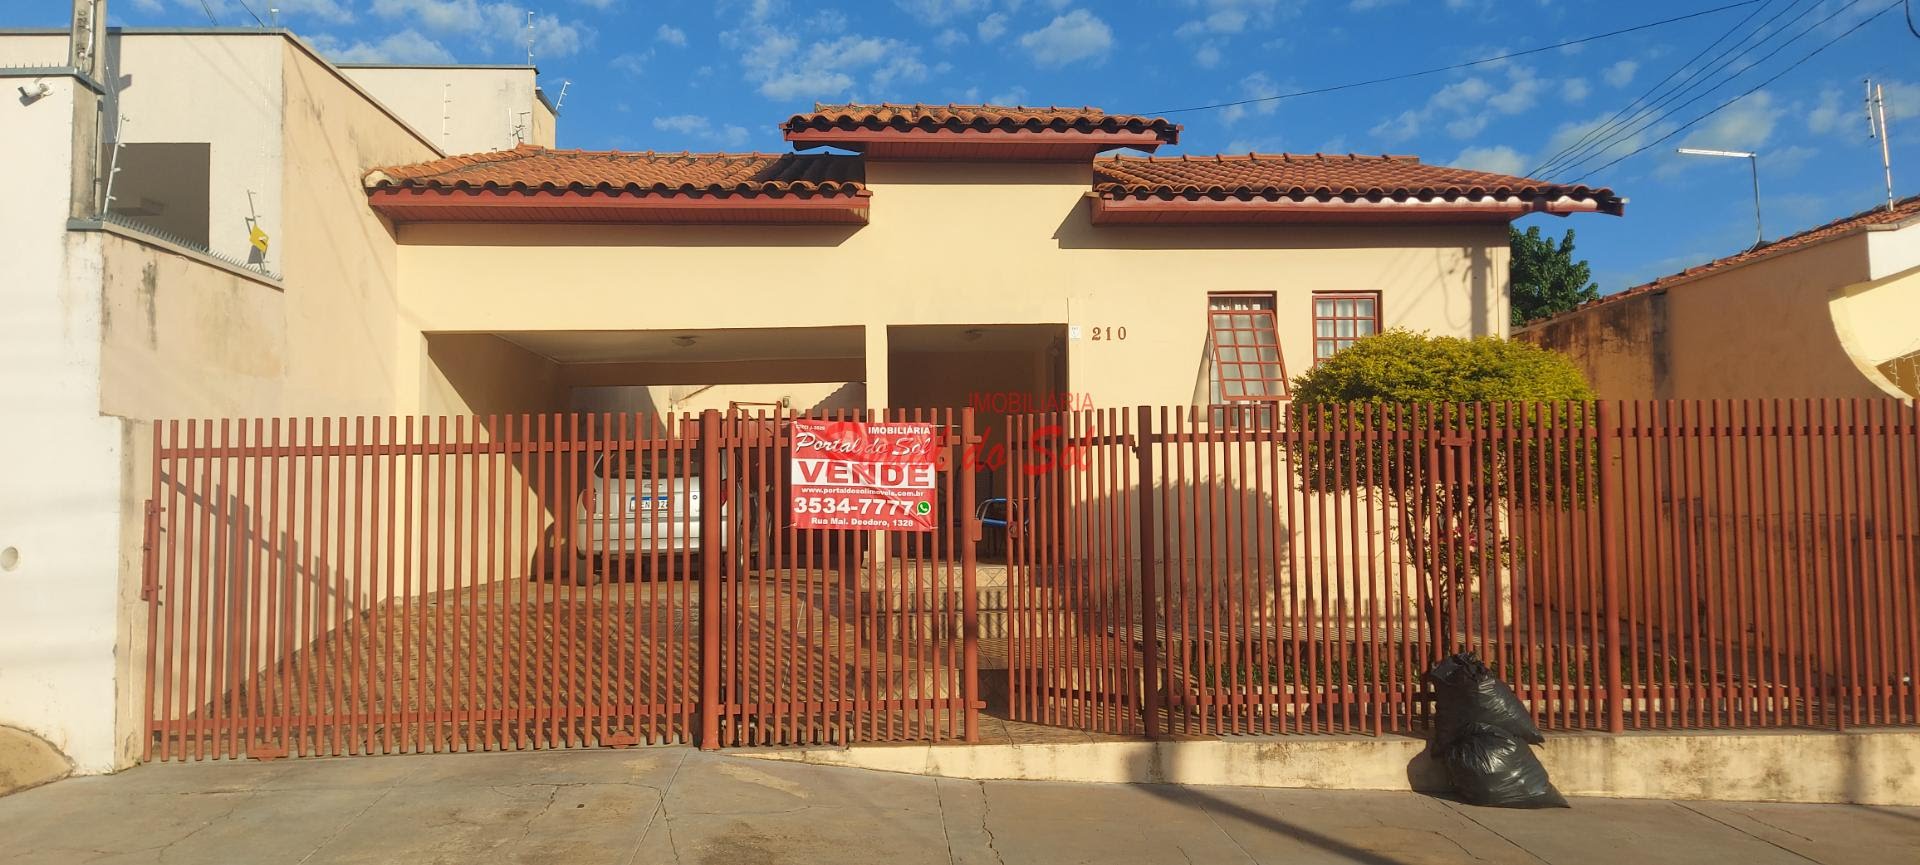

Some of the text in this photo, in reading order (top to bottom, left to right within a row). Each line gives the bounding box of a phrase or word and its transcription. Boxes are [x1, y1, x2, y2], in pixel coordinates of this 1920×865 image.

[1092, 326, 1127, 341] 210
[868, 425, 931, 435] IMOBILIÁRIA
[795, 432, 931, 456] Portal do Sol
[798, 461, 930, 487] VENDE
[793, 497, 914, 516] 3534-7777
[811, 517, 828, 525] Rua
[851, 519, 890, 527] Deodoro,
